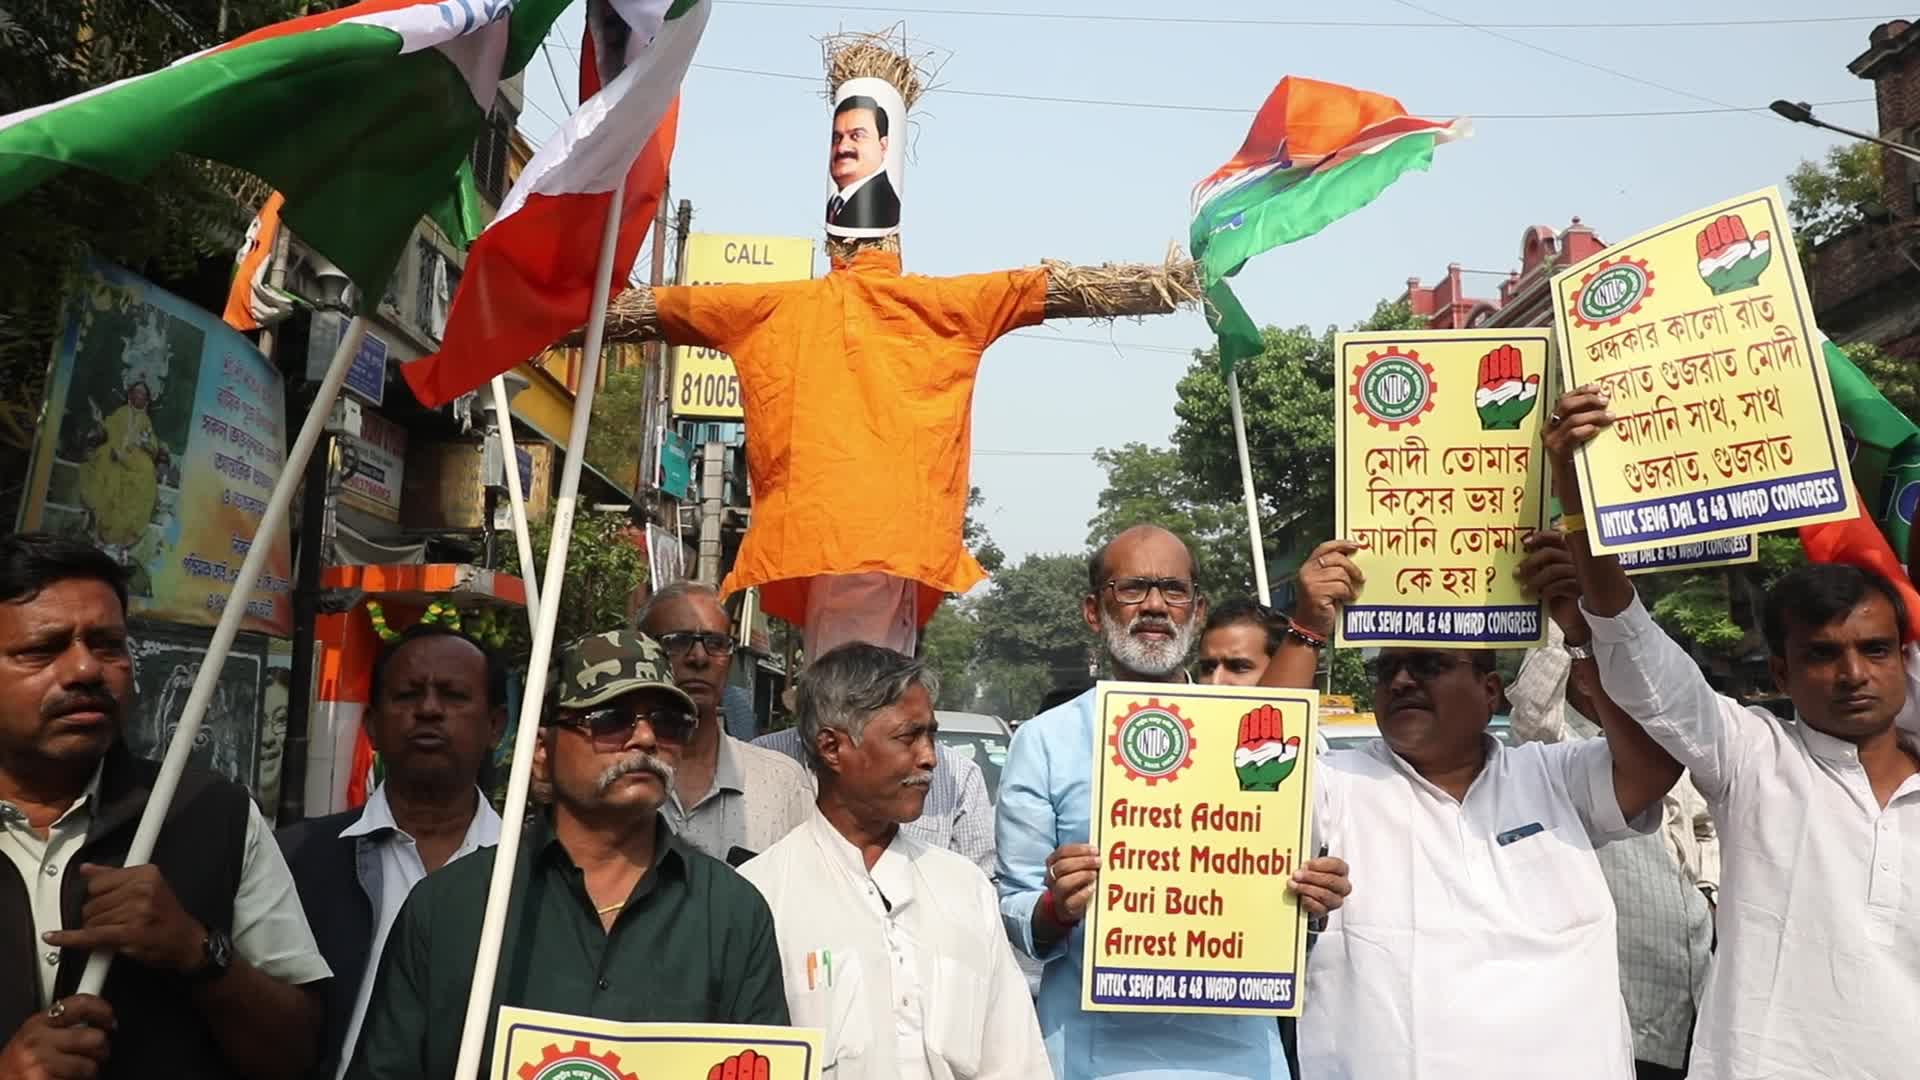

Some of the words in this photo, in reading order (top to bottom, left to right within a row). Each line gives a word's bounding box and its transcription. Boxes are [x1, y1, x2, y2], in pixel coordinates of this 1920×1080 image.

[724, 242, 774, 265] CALL
[1585, 322, 1658, 363] অন্ধকার
[1661, 304, 1729, 343] কালো
[1730, 295, 1775, 329] রাত
[1594, 364, 1654, 404] জরাত
[1661, 346, 1737, 390] গুজরাত
[1747, 325, 1801, 375] মোদী
[682, 372, 744, 407] 81005
[1380, 374, 1409, 403] INTUC
[1612, 395, 1682, 446] আদানি
[1737, 384, 1784, 424] সাথ
[1365, 436, 1429, 476] মোদী
[1443, 443, 1529, 476] তোমার
[1711, 433, 1794, 478] গুজরাত
[1366, 477, 1455, 517] কিসের
[1600, 508, 1638, 538] INTUC
[1639, 506, 1669, 533] SEVA
[1671, 500, 1697, 528] DAL
[1697, 498, 1709, 524] &
[1710, 494, 1728, 521] 48
[1727, 489, 1770, 520] WARD
[1770, 477, 1840, 512] CONGRESS
[1351, 516, 1437, 556] আদানি
[1678, 541, 1704, 559] WARD
[1705, 535, 1748, 556] CONGRESS
[1396, 568, 1433, 595] কে
[1348, 611, 1376, 634] INTUC
[1378, 611, 1403, 635] SEVA
[1405, 611, 1425, 635] DAL
[1428, 612, 1436, 634] &
[1438, 611, 1450, 634] 48
[1454, 611, 1485, 636] WARD
[1487, 611, 1537, 635] CONGRESS
[1140, 727, 1169, 757] INTUC
[1110, 798, 1182, 829] Arrest
[1191, 803, 1262, 833] Adani
[1109, 841, 1180, 873] Arrest
[1189, 844, 1292, 876] Madhabi
[1107, 883, 1156, 914] Puri
[1165, 887, 1223, 916] Buch
[1104, 927, 1177, 957] Arrest
[1185, 930, 1244, 959] Modi
[1096, 973, 1127, 997] INTUC
[1129, 973, 1153, 1000] SEVA
[1156, 975, 1176, 1000] DAL
[1178, 976, 1187, 999] &
[1189, 975, 1203, 999] 48
[1204, 976, 1237, 1002] WARD
[1239, 977, 1292, 1003] CONGRESS
